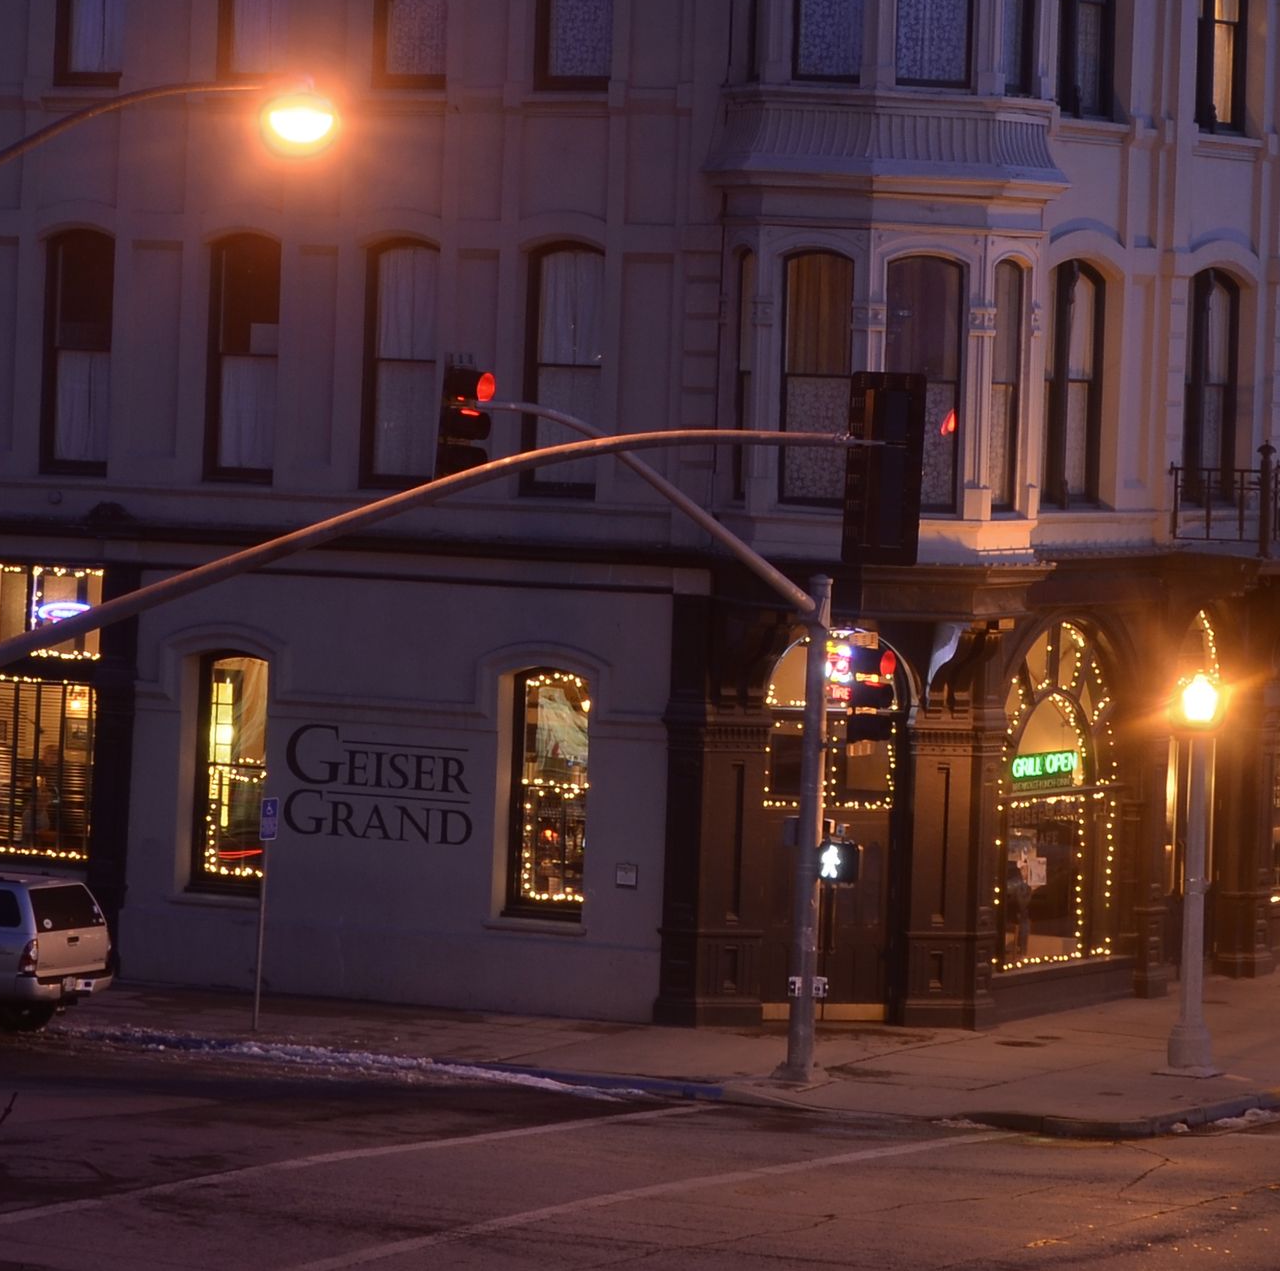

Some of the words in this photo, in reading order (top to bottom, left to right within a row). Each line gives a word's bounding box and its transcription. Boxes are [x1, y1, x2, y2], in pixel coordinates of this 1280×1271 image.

[285, 724, 471, 794] GEISER
[1012, 756, 1043, 778] GRILL
[1045, 752, 1078, 773] OPEN
[282, 789, 473, 846] GRAND
